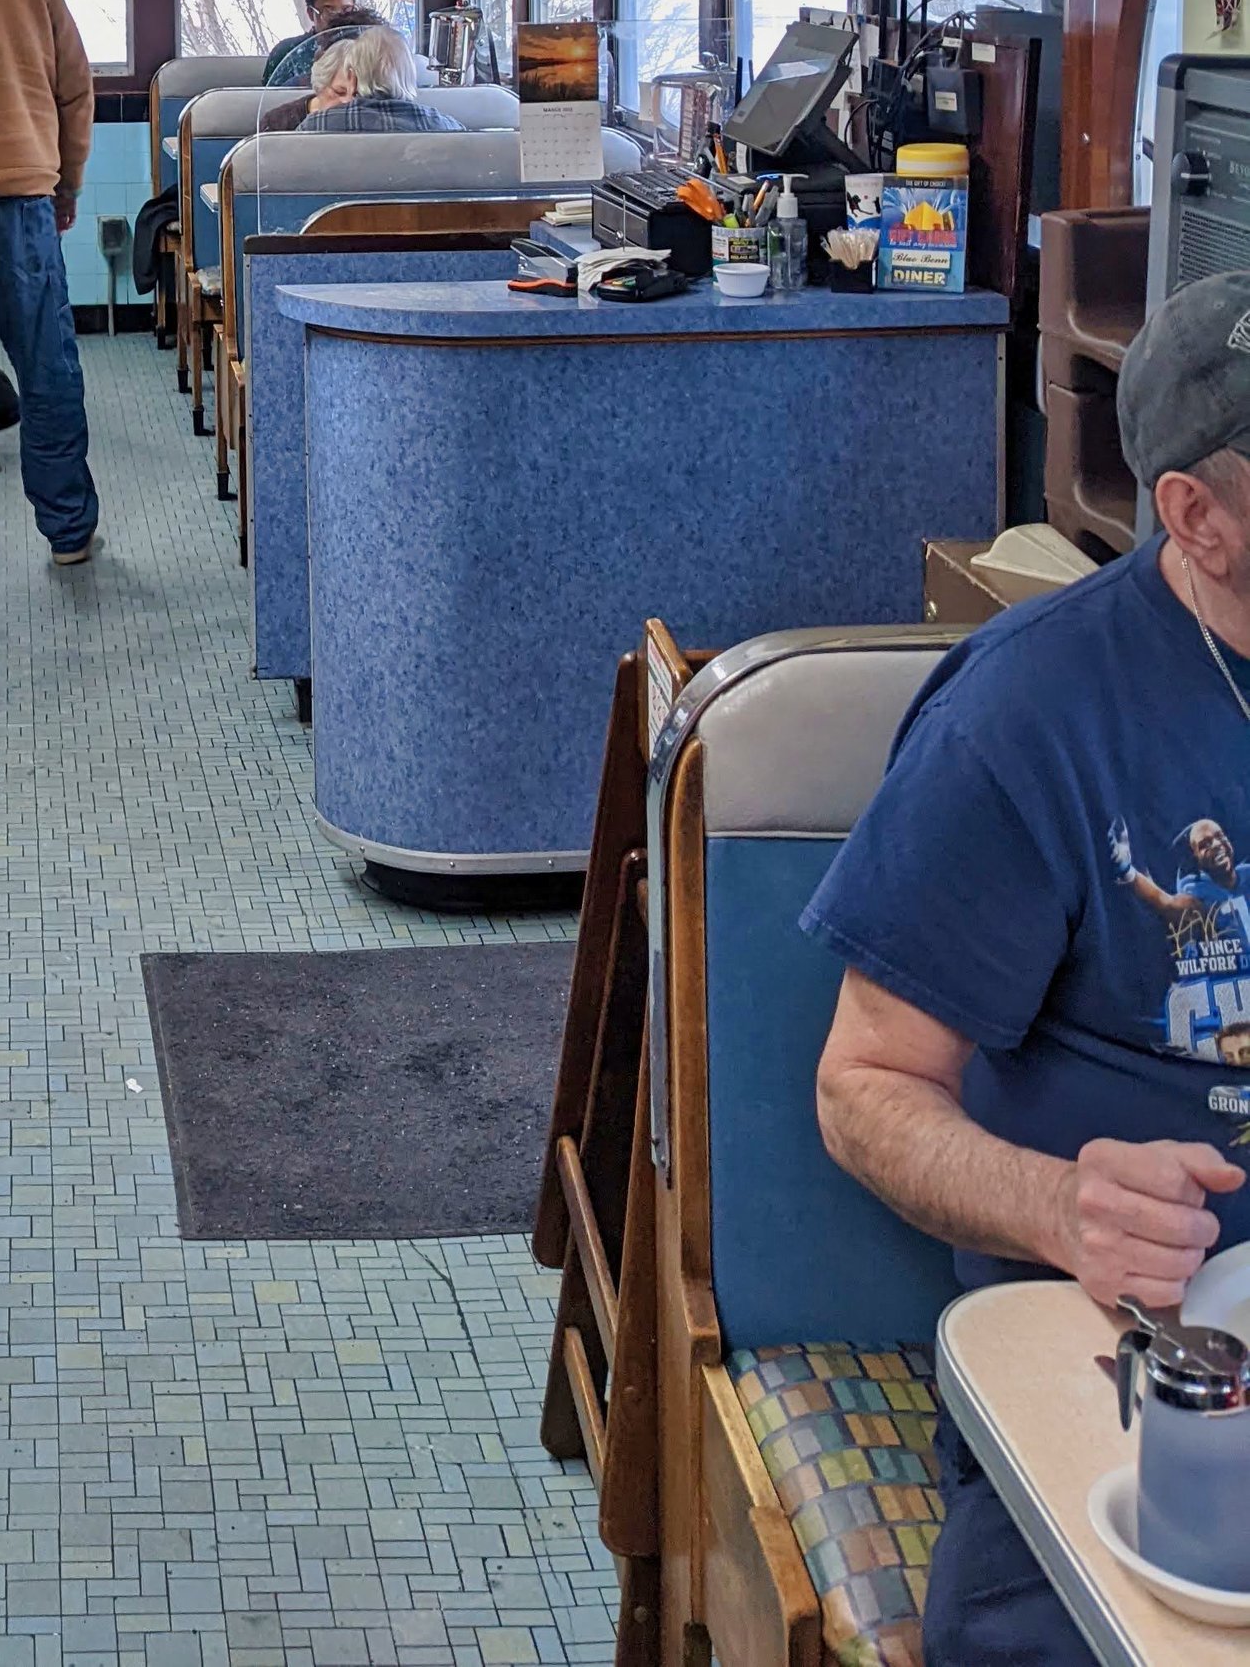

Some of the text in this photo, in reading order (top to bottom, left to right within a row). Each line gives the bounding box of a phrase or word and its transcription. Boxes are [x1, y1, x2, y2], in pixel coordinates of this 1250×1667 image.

[893, 253, 917, 262] Blue
[893, 269, 946, 284] DINER
[1198, 938, 1243, 956] VINCE
[1175, 955, 1237, 975] WILFORK
